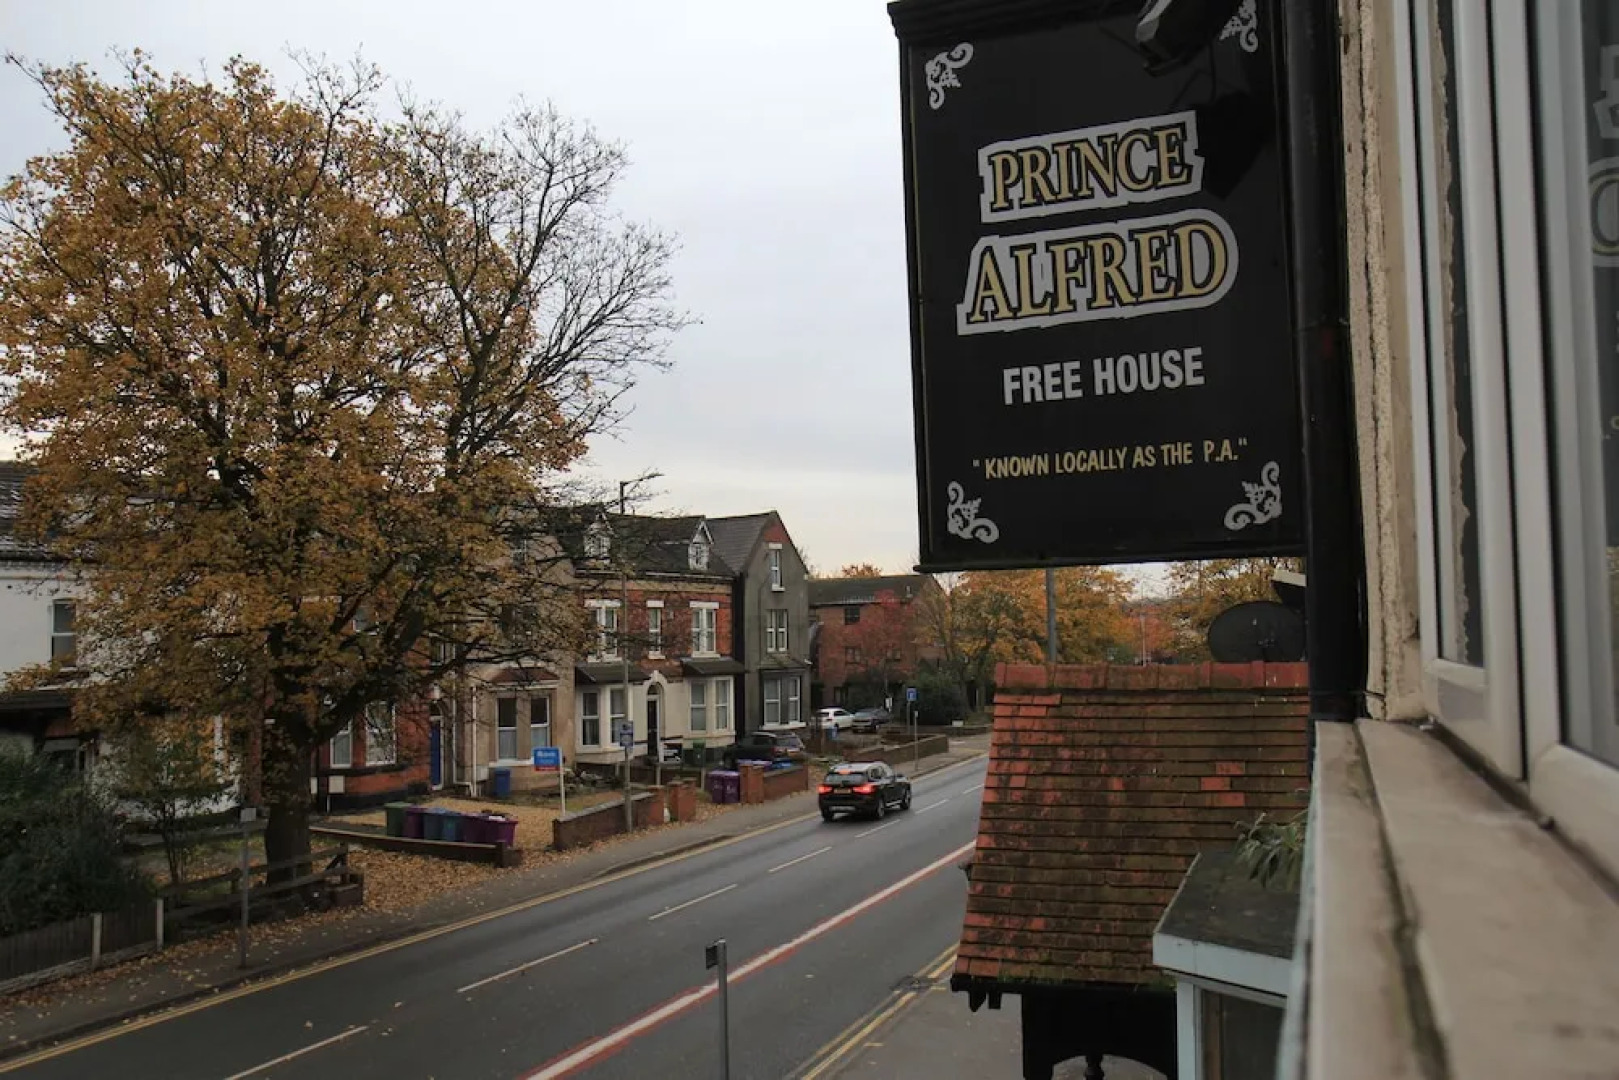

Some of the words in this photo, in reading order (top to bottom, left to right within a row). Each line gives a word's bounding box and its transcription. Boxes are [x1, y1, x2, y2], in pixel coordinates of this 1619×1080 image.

[988, 120, 1194, 212] PRINCE
[966, 219, 1228, 325] ALFRED
[1003, 361, 1083, 405] FREE
[1093, 347, 1205, 395] HOUSE
[1055, 447, 1127, 473] LOCALLY
[1132, 446, 1156, 469] AS
[1161, 442, 1193, 466] THE
